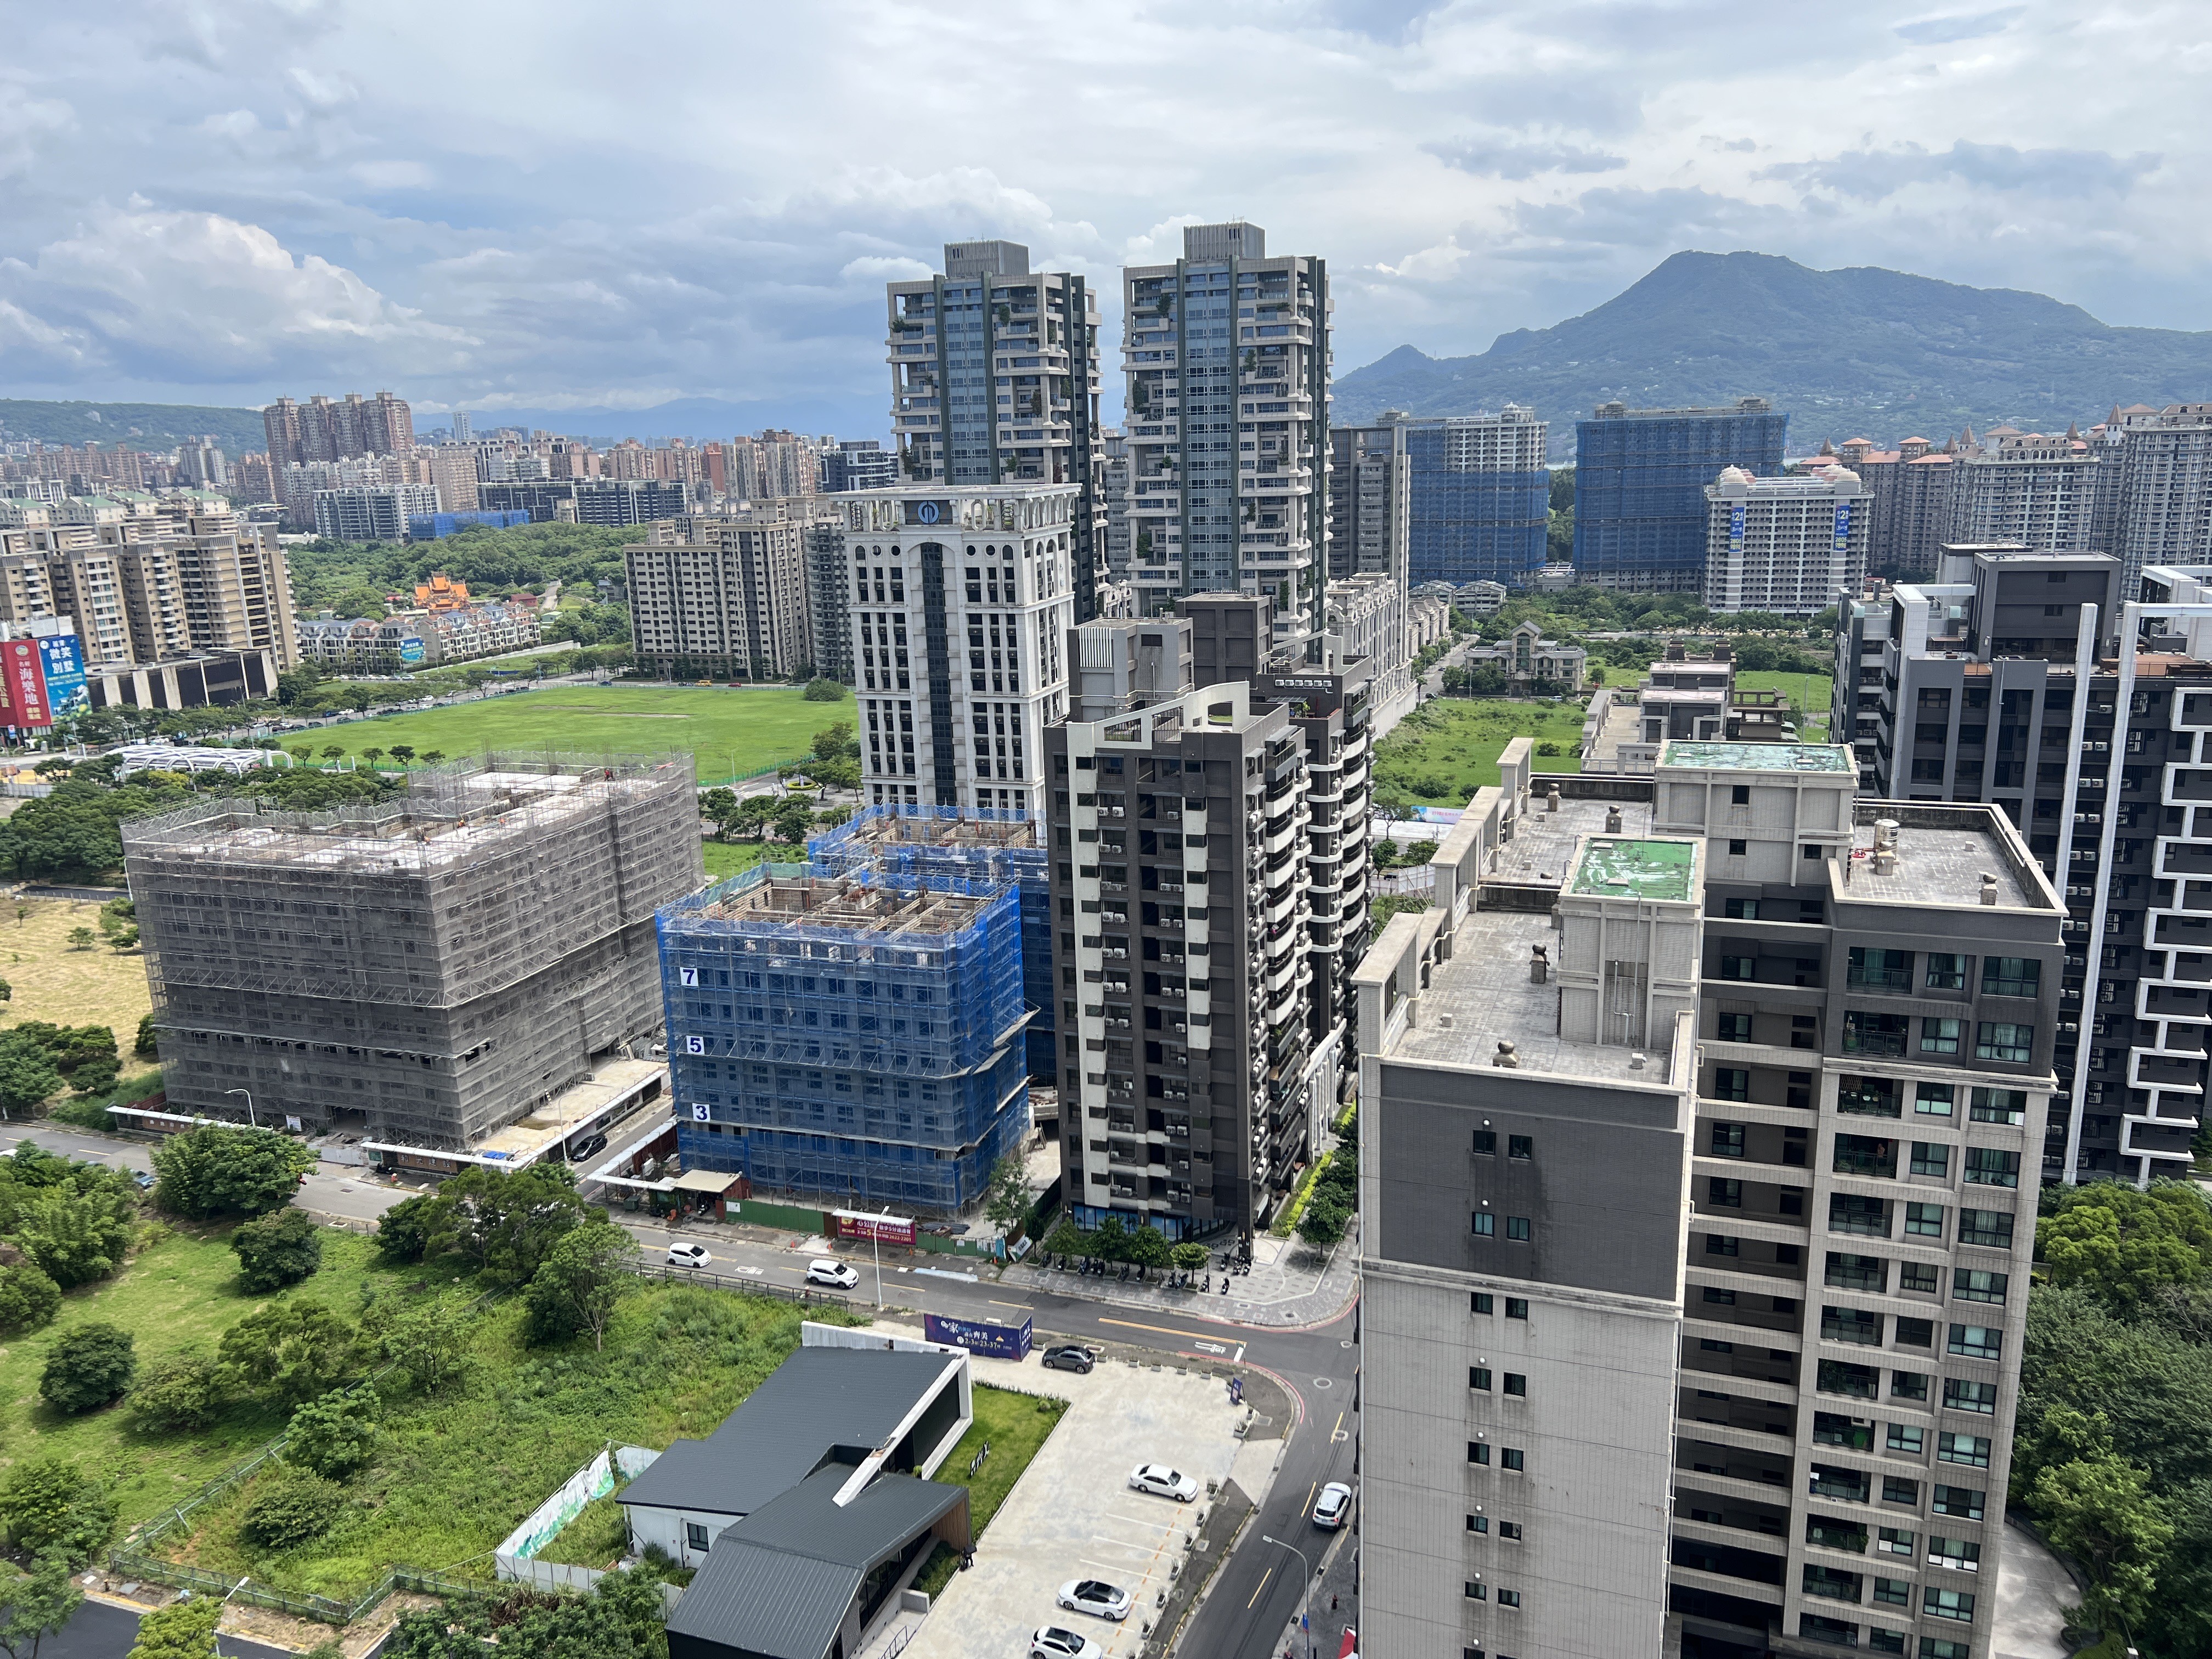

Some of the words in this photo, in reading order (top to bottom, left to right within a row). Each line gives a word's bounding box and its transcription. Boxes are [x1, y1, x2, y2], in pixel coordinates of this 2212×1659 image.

[49, 646, 73, 660] 微笑
[52, 660, 76, 674] 別墅
[19, 668, 40, 705] 海樂地
[683, 969, 695, 984] 7
[690, 1037, 702, 1052] 5
[696, 1105, 707, 1120] 3
[401, 1154, 451, 1168] 和光建設
